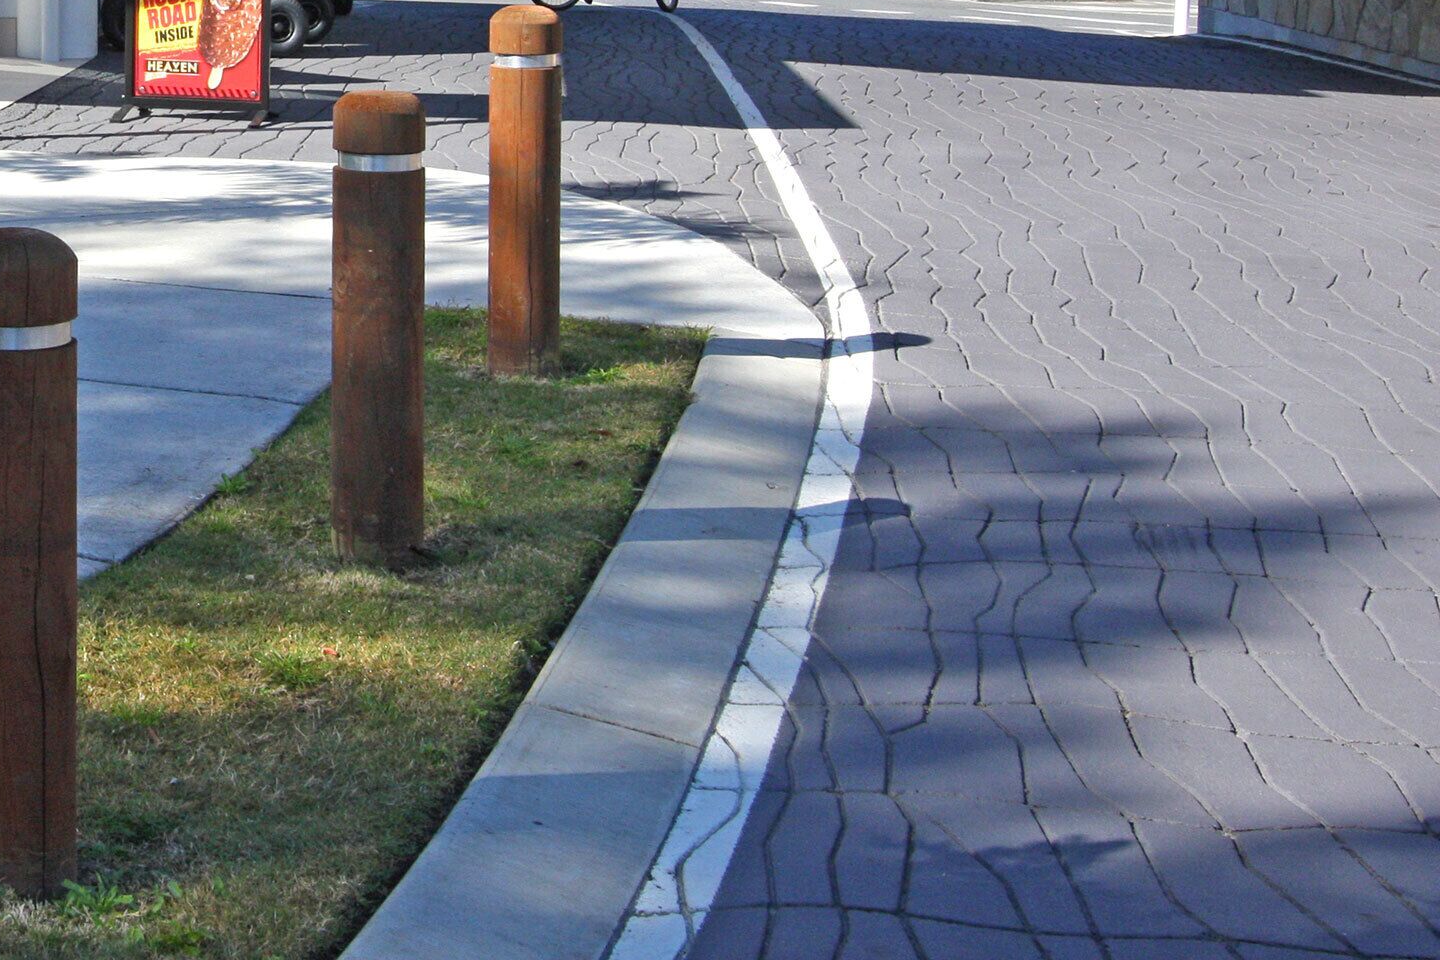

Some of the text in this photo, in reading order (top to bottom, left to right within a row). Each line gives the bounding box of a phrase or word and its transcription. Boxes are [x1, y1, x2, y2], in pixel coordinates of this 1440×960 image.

[147, 1, 197, 30] ROAD
[155, 26, 194, 44] INSIDE
[147, 60, 198, 74] HEAVEN
